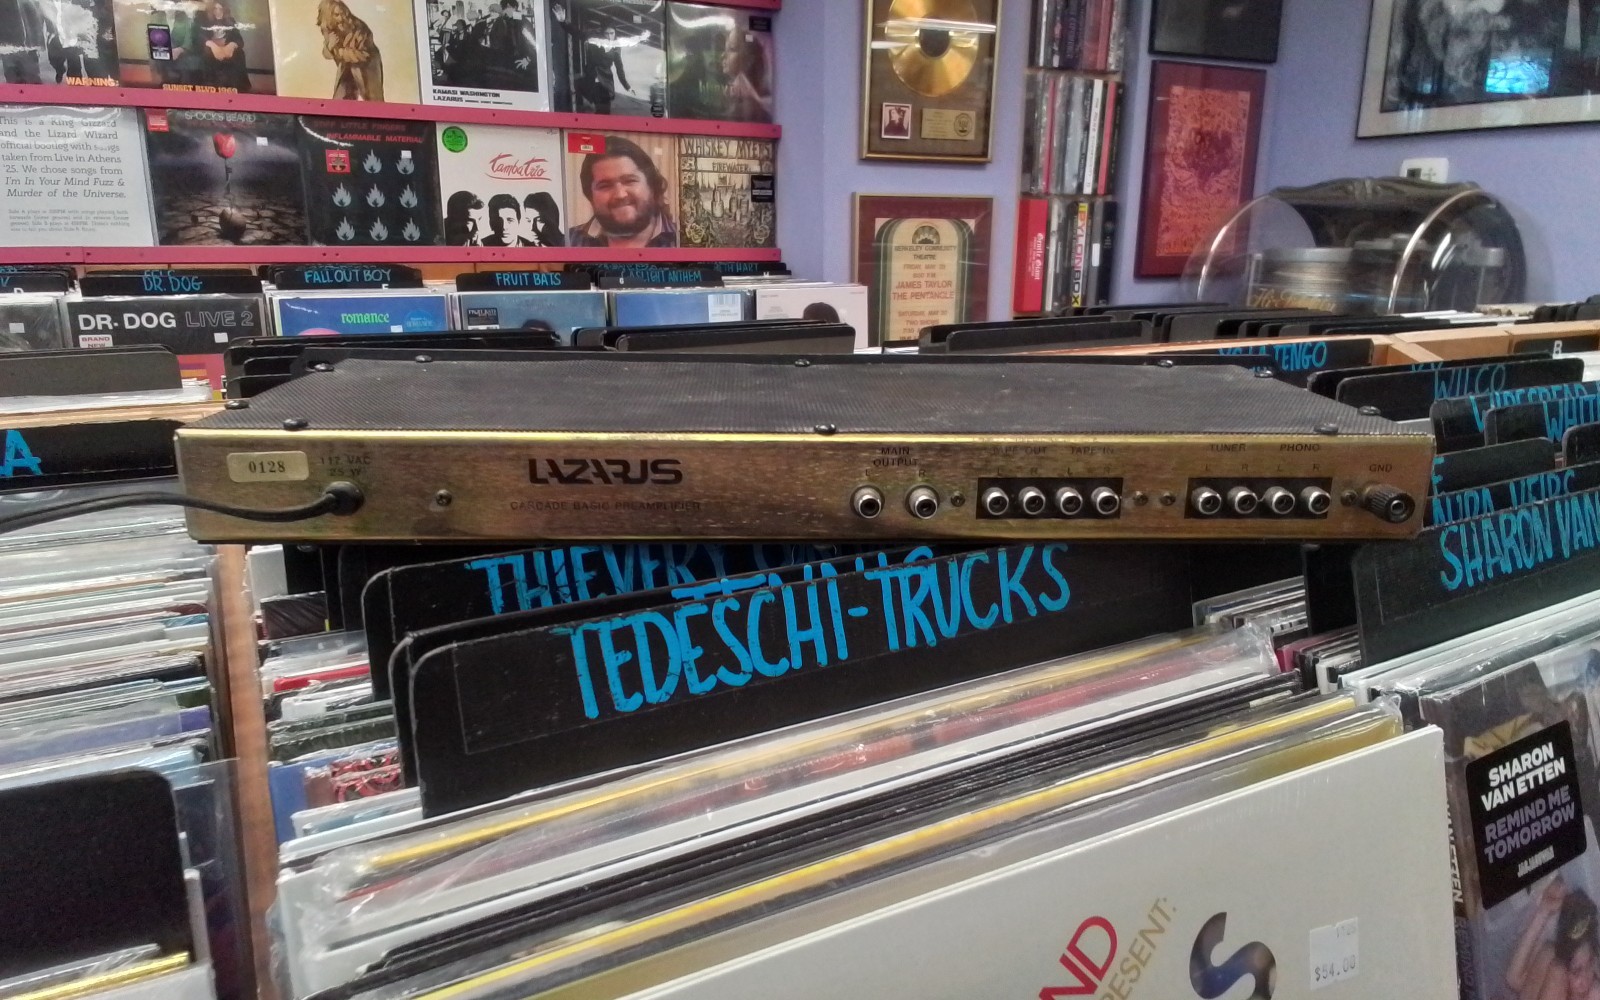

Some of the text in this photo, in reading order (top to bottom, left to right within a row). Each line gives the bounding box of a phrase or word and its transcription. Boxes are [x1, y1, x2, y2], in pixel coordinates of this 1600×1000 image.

[66, 77, 119, 87] WARNING:
[163, 83, 193, 92] SUNSET
[195, 85, 216, 93] BLVD
[433, 88, 500, 98] KAMASI WASHINGTON
[0, 115, 18, 126] This
[25, 117, 32, 125] is
[0, 129, 118, 139] and the Lizard Wizard
[327, 133, 423, 143] INFLAMMABLE MATERIAL
[1, 141, 32, 150] official
[34, 141, 69, 152] bootleg
[70, 142, 92, 151] with
[682, 138, 773, 158] WHISKEY MYERS
[1, 153, 122, 163] taken from Live in Athens
[489, 152, 549, 177] Tamba Trio
[712, 161, 751, 172] FIREWATER
[22, 165, 37, 173] We
[41, 165, 67, 174] chose
[71, 167, 97, 176] songs
[100, 166, 123, 175] from
[5, 177, 125, 187] I'm In Your Mind Fuzz &
[7, 188, 127, 198] Murder of the Universe.
[304, 269, 391, 283] FALL OUT BOY
[495, 272, 562, 286] FRUIT BATS
[169, 276, 203, 292] DOG
[924, 280, 952, 288] TAYLOR
[892, 291, 954, 300] THE PENTANGLE
[78, 310, 254, 330] DR. DOG LIVE 2
[341, 312, 390, 324] romance
[1553, 340, 1563, 355] B
[1273, 341, 1327, 371] TENGO
[1434, 363, 1506, 401] WILCO
[1543, 394, 1600, 444] WHIT
[881, 447, 910, 455] MAIN
[1210, 444, 1320, 452] TUNER PHONO
[0, 430, 43, 478] A
[249, 461, 286, 474] 0128
[873, 458, 918, 467] OUTPUT
[1369, 464, 1392, 472] GND
[528, 458, 683, 485] LAZARUS
[918, 469, 926, 477] R
[510, 501, 567, 511] CASCADE
[573, 501, 610, 511] BASIC
[1440, 502, 1553, 591] SHARON
[1488, 742, 1554, 787] SHARON
[1481, 757, 1566, 811] VAN ETTEN
[1484, 797, 1547, 843] REMIND
[1548, 784, 1571, 807] ME
[1484, 802, 1575, 865] TOMORROW
[1313, 954, 1357, 982] $54.00
